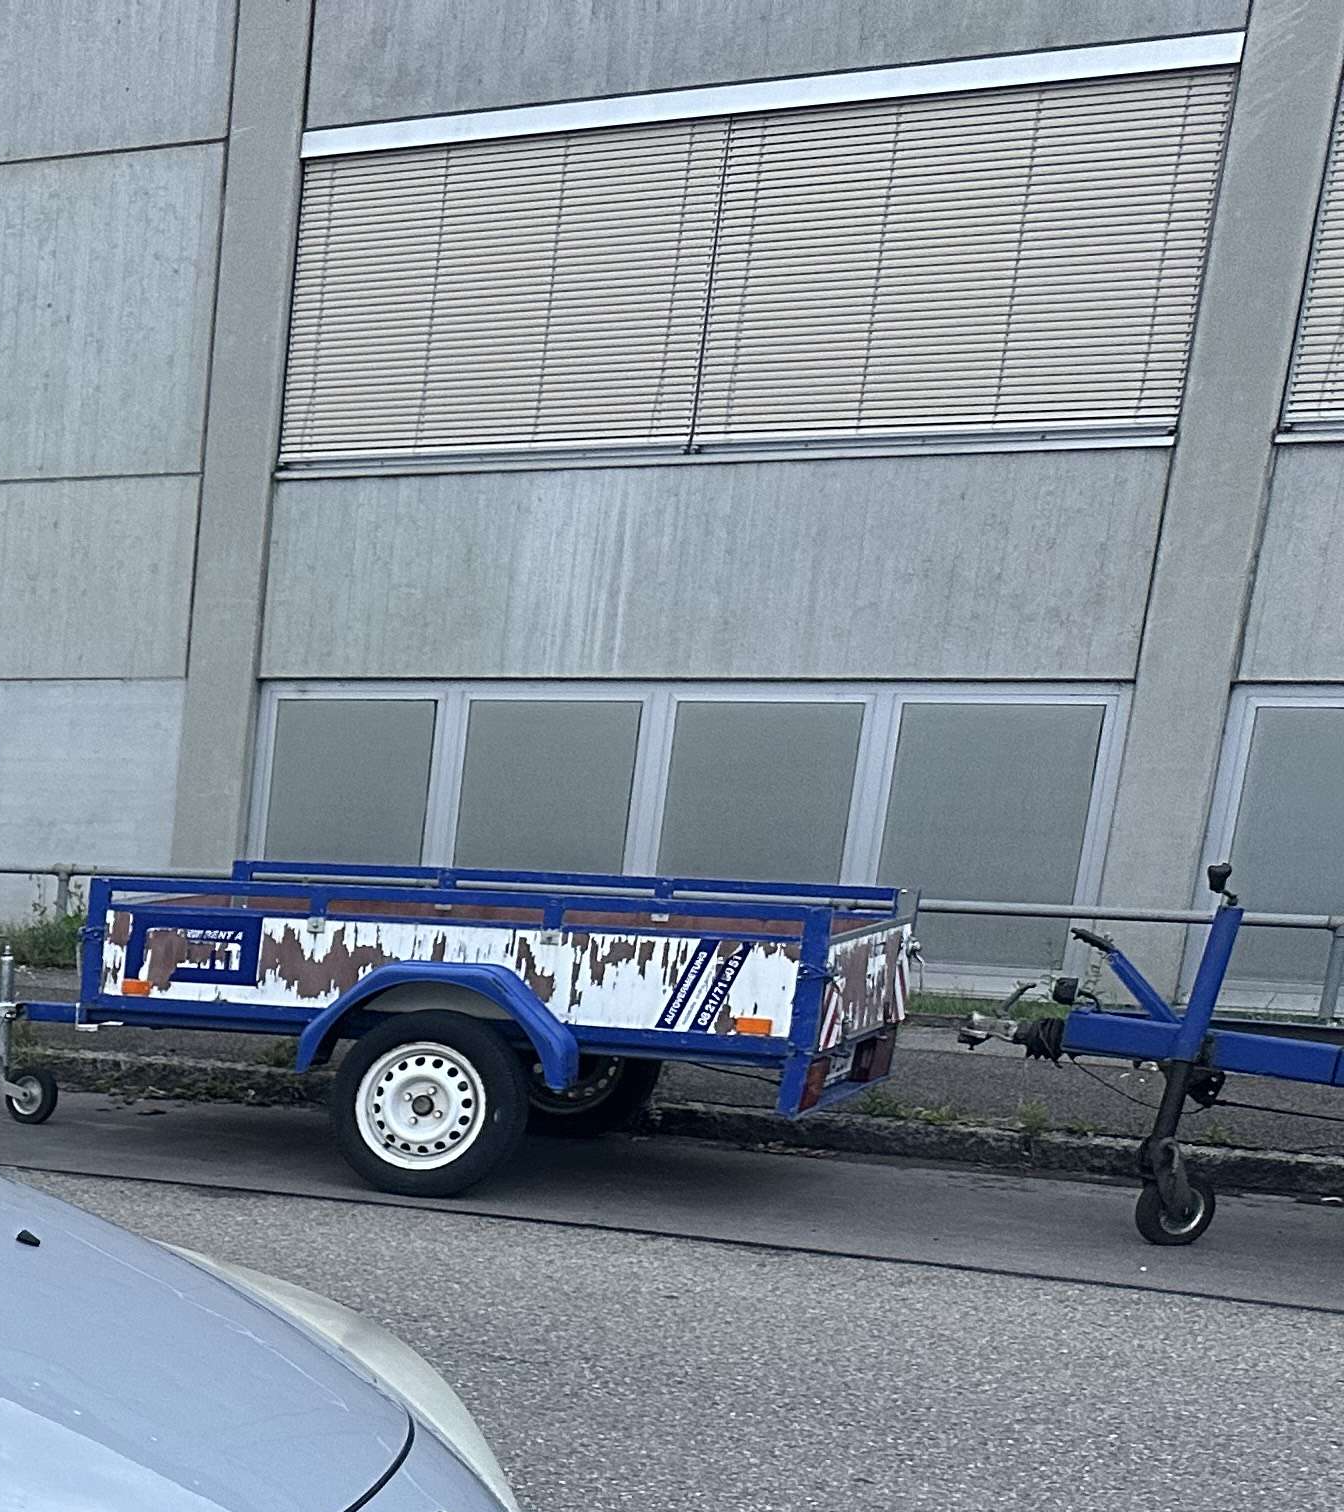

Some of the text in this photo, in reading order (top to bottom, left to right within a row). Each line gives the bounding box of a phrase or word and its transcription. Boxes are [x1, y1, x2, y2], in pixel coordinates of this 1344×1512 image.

[204, 930, 234, 940] RENT
[234, 931, 244, 940] A
[664, 951, 708, 1025] AUTOVERMIETUNG
